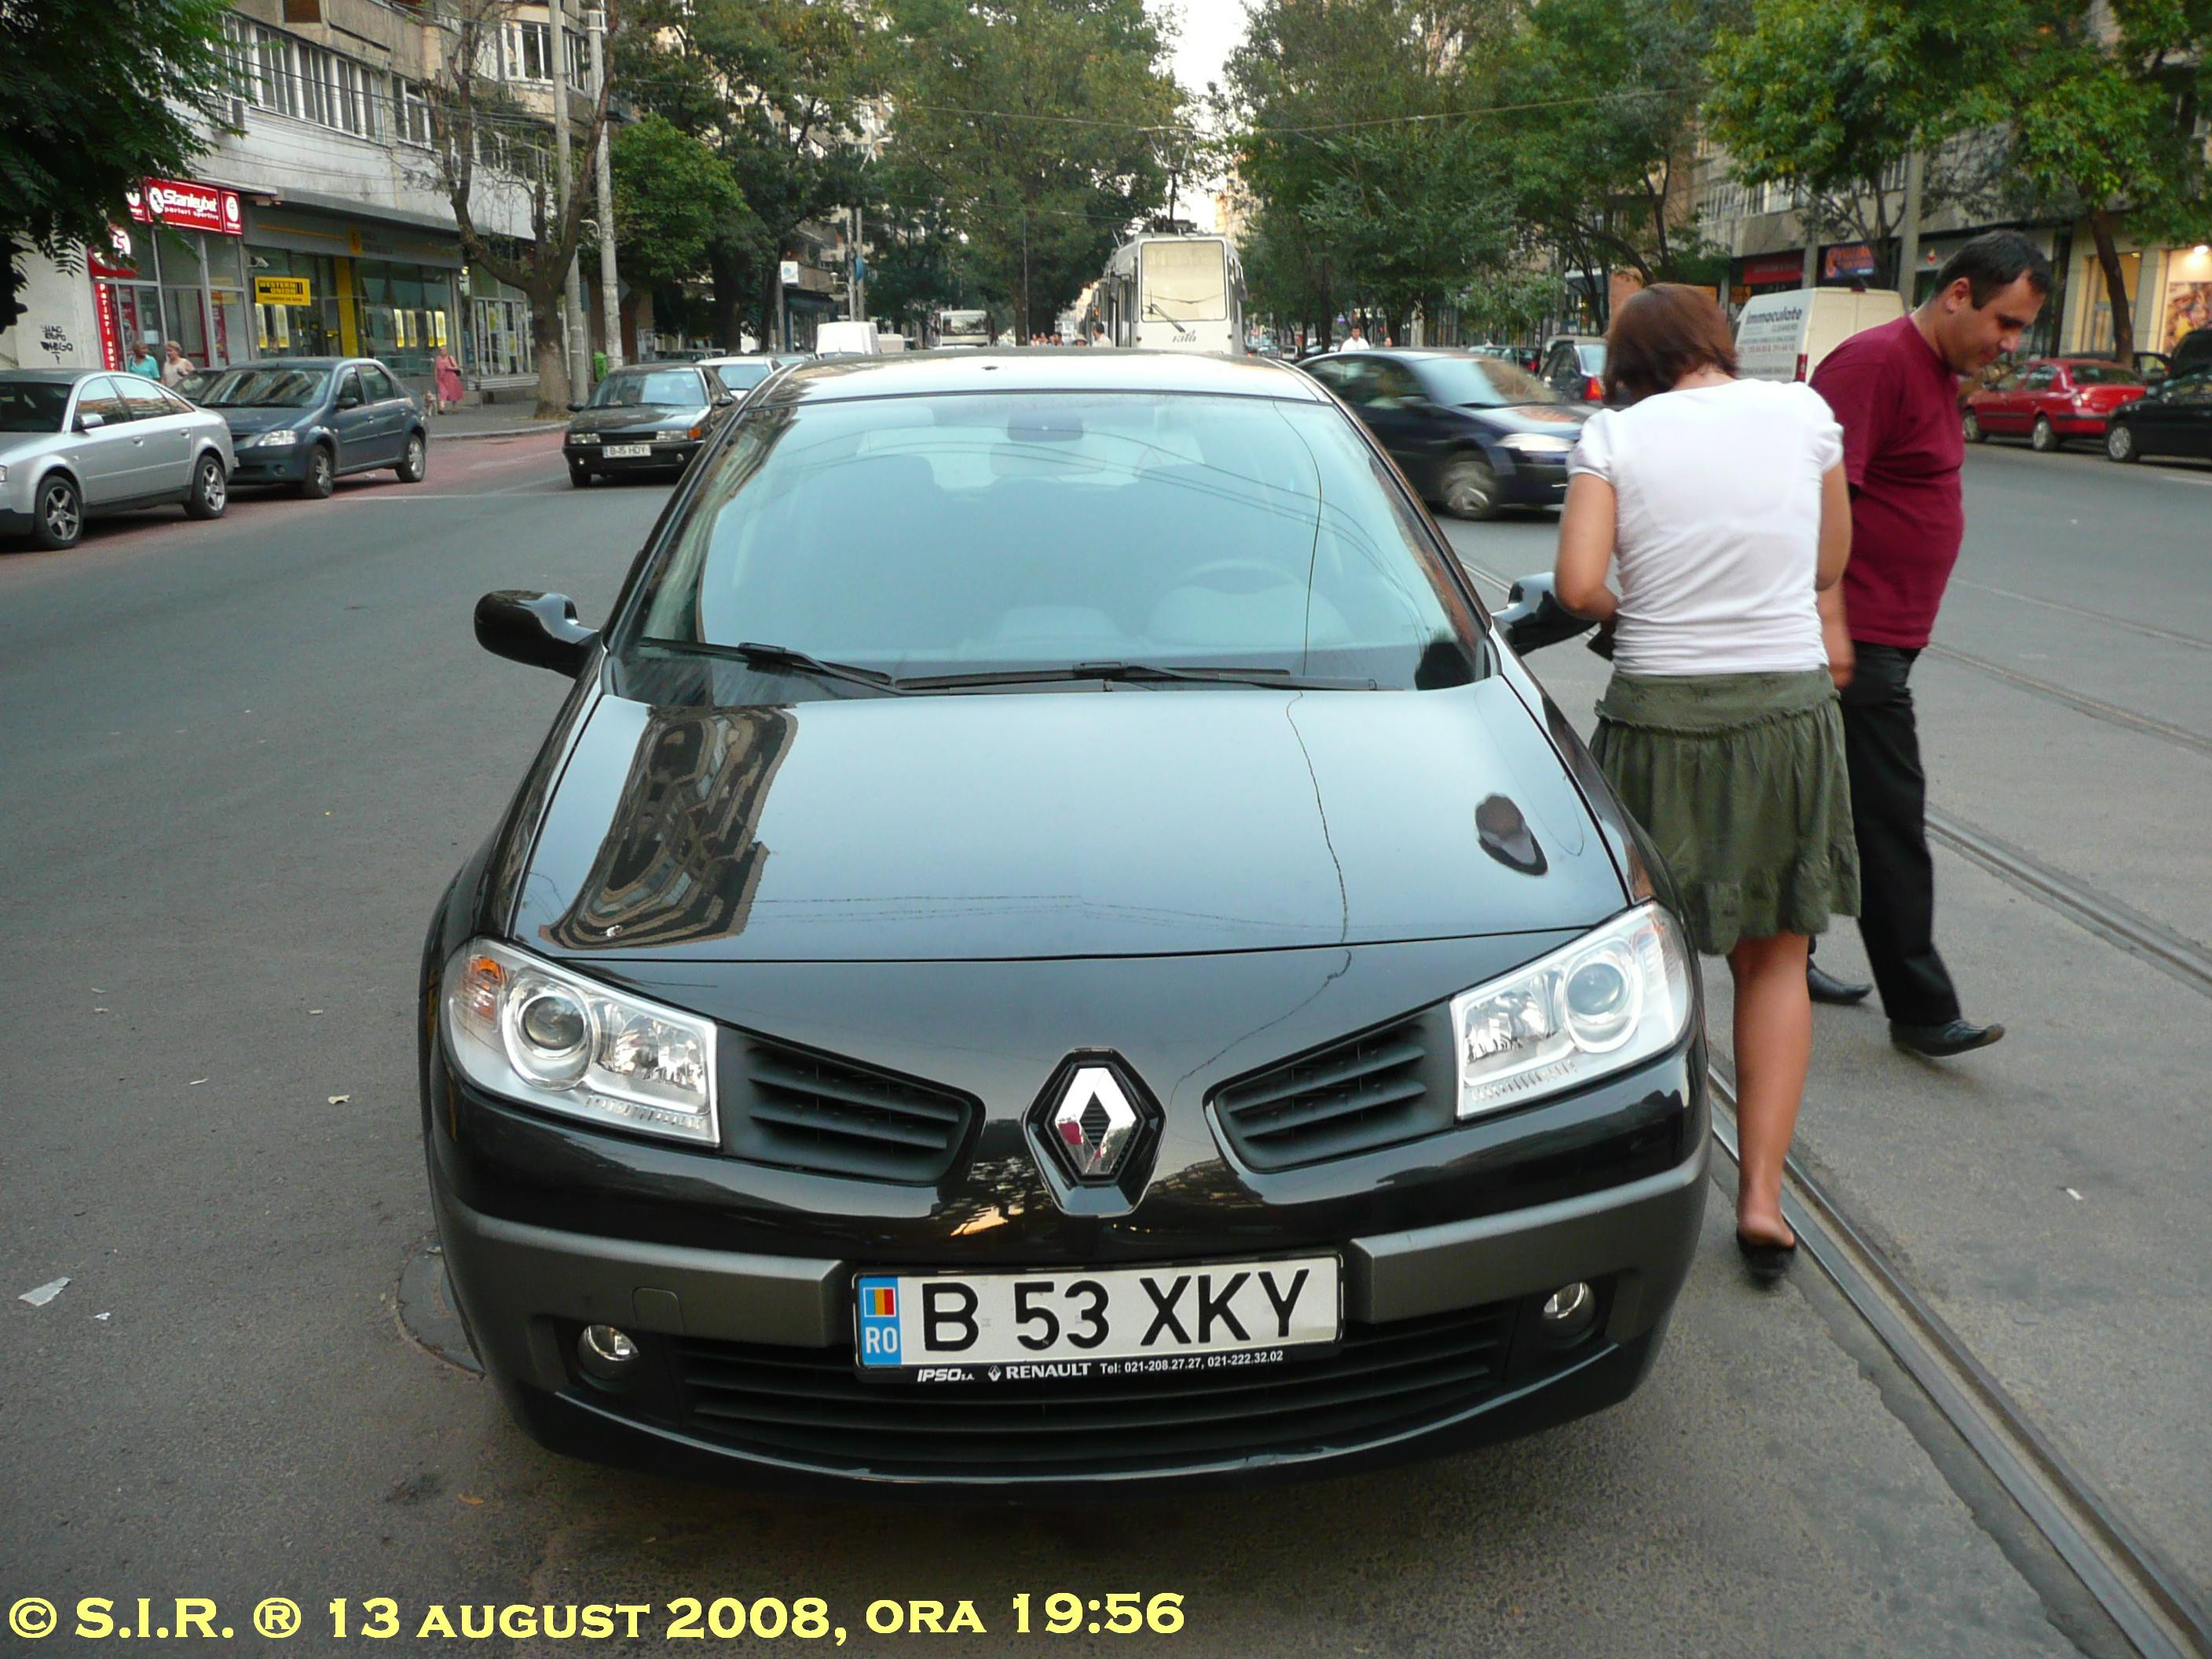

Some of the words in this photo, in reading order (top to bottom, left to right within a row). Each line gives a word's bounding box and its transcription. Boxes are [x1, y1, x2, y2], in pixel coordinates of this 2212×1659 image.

[163, 189, 218, 212] Stanleybet
[921, 1281, 980, 1352] B
[1014, 1280, 1110, 1352] 53
[1140, 1268, 1310, 1346] XKY
[866, 1326, 898, 1354] RO
[1005, 1362, 1092, 1380] RENAULT
[1100, 1362, 1122, 1374] Tel:
[1124, 1357, 1205, 1373] 021-208.27.27,
[1207, 1350, 1284, 1368] 021-222.32.02
